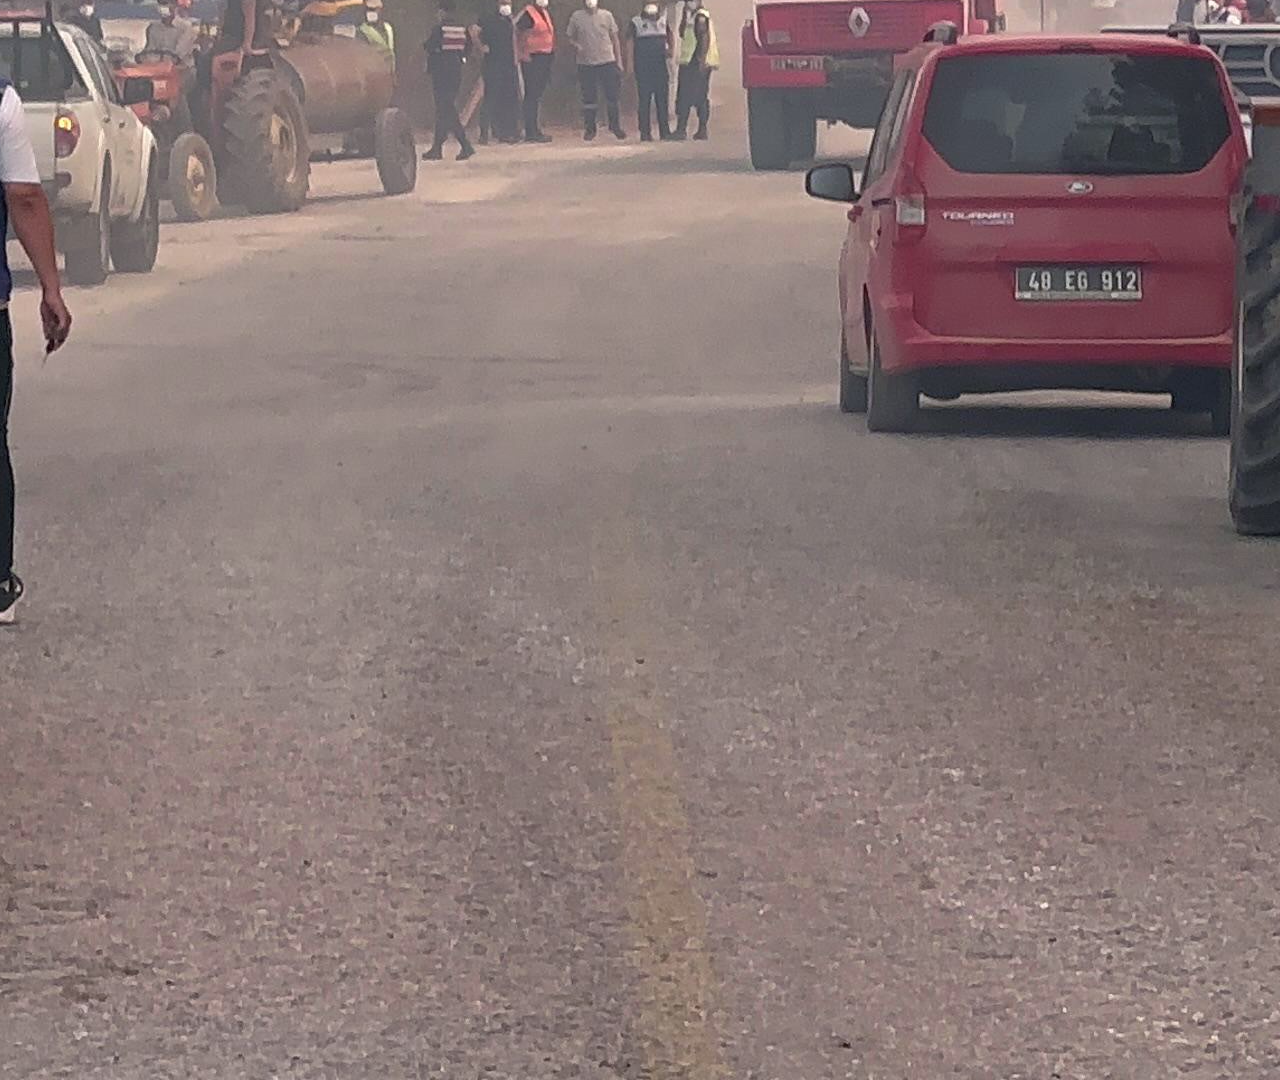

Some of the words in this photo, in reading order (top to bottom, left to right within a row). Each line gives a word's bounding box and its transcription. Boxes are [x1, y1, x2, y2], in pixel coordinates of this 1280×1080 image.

[1028, 271, 1051, 291] 48
[1065, 271, 1088, 291] EG
[1101, 270, 1137, 291] 912
